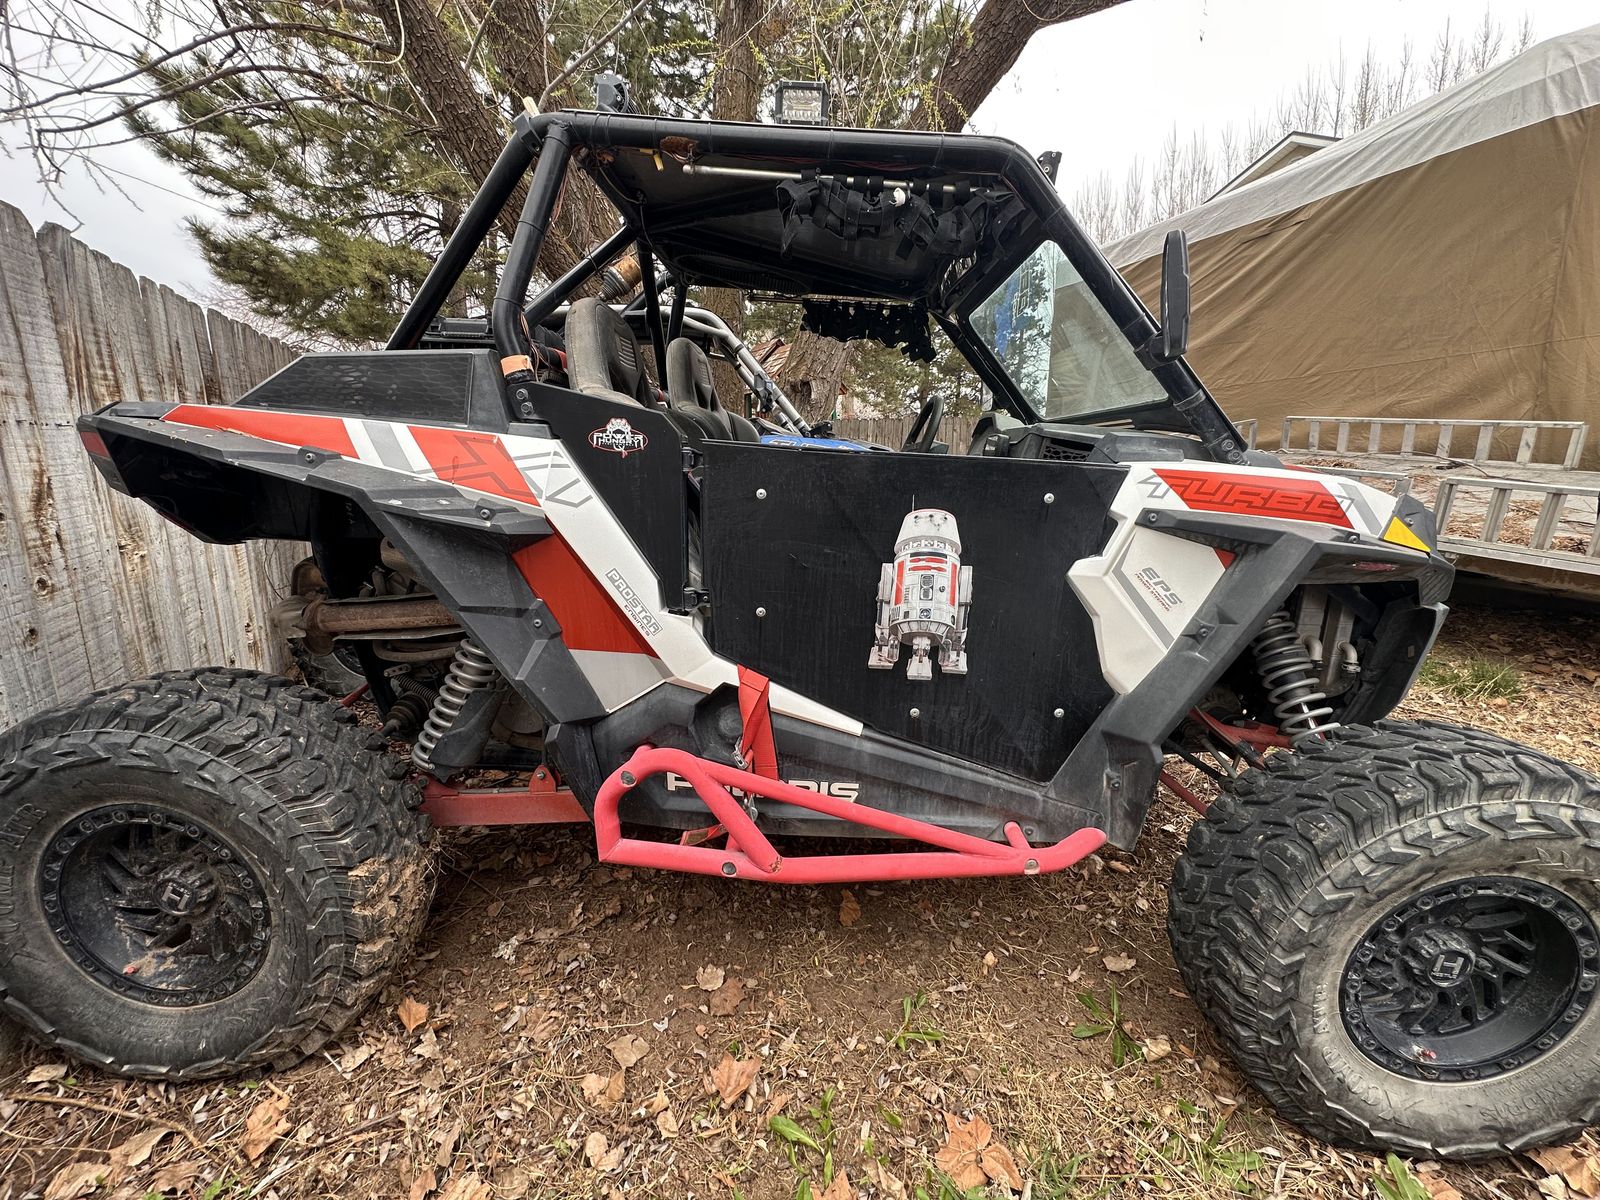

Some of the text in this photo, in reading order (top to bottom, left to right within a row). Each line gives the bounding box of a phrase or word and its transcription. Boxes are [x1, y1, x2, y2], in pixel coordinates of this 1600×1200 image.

[1137, 474, 1355, 519] TURBO
[605, 568, 663, 636] PROSTAR
[1141, 566, 1183, 605] EPS
